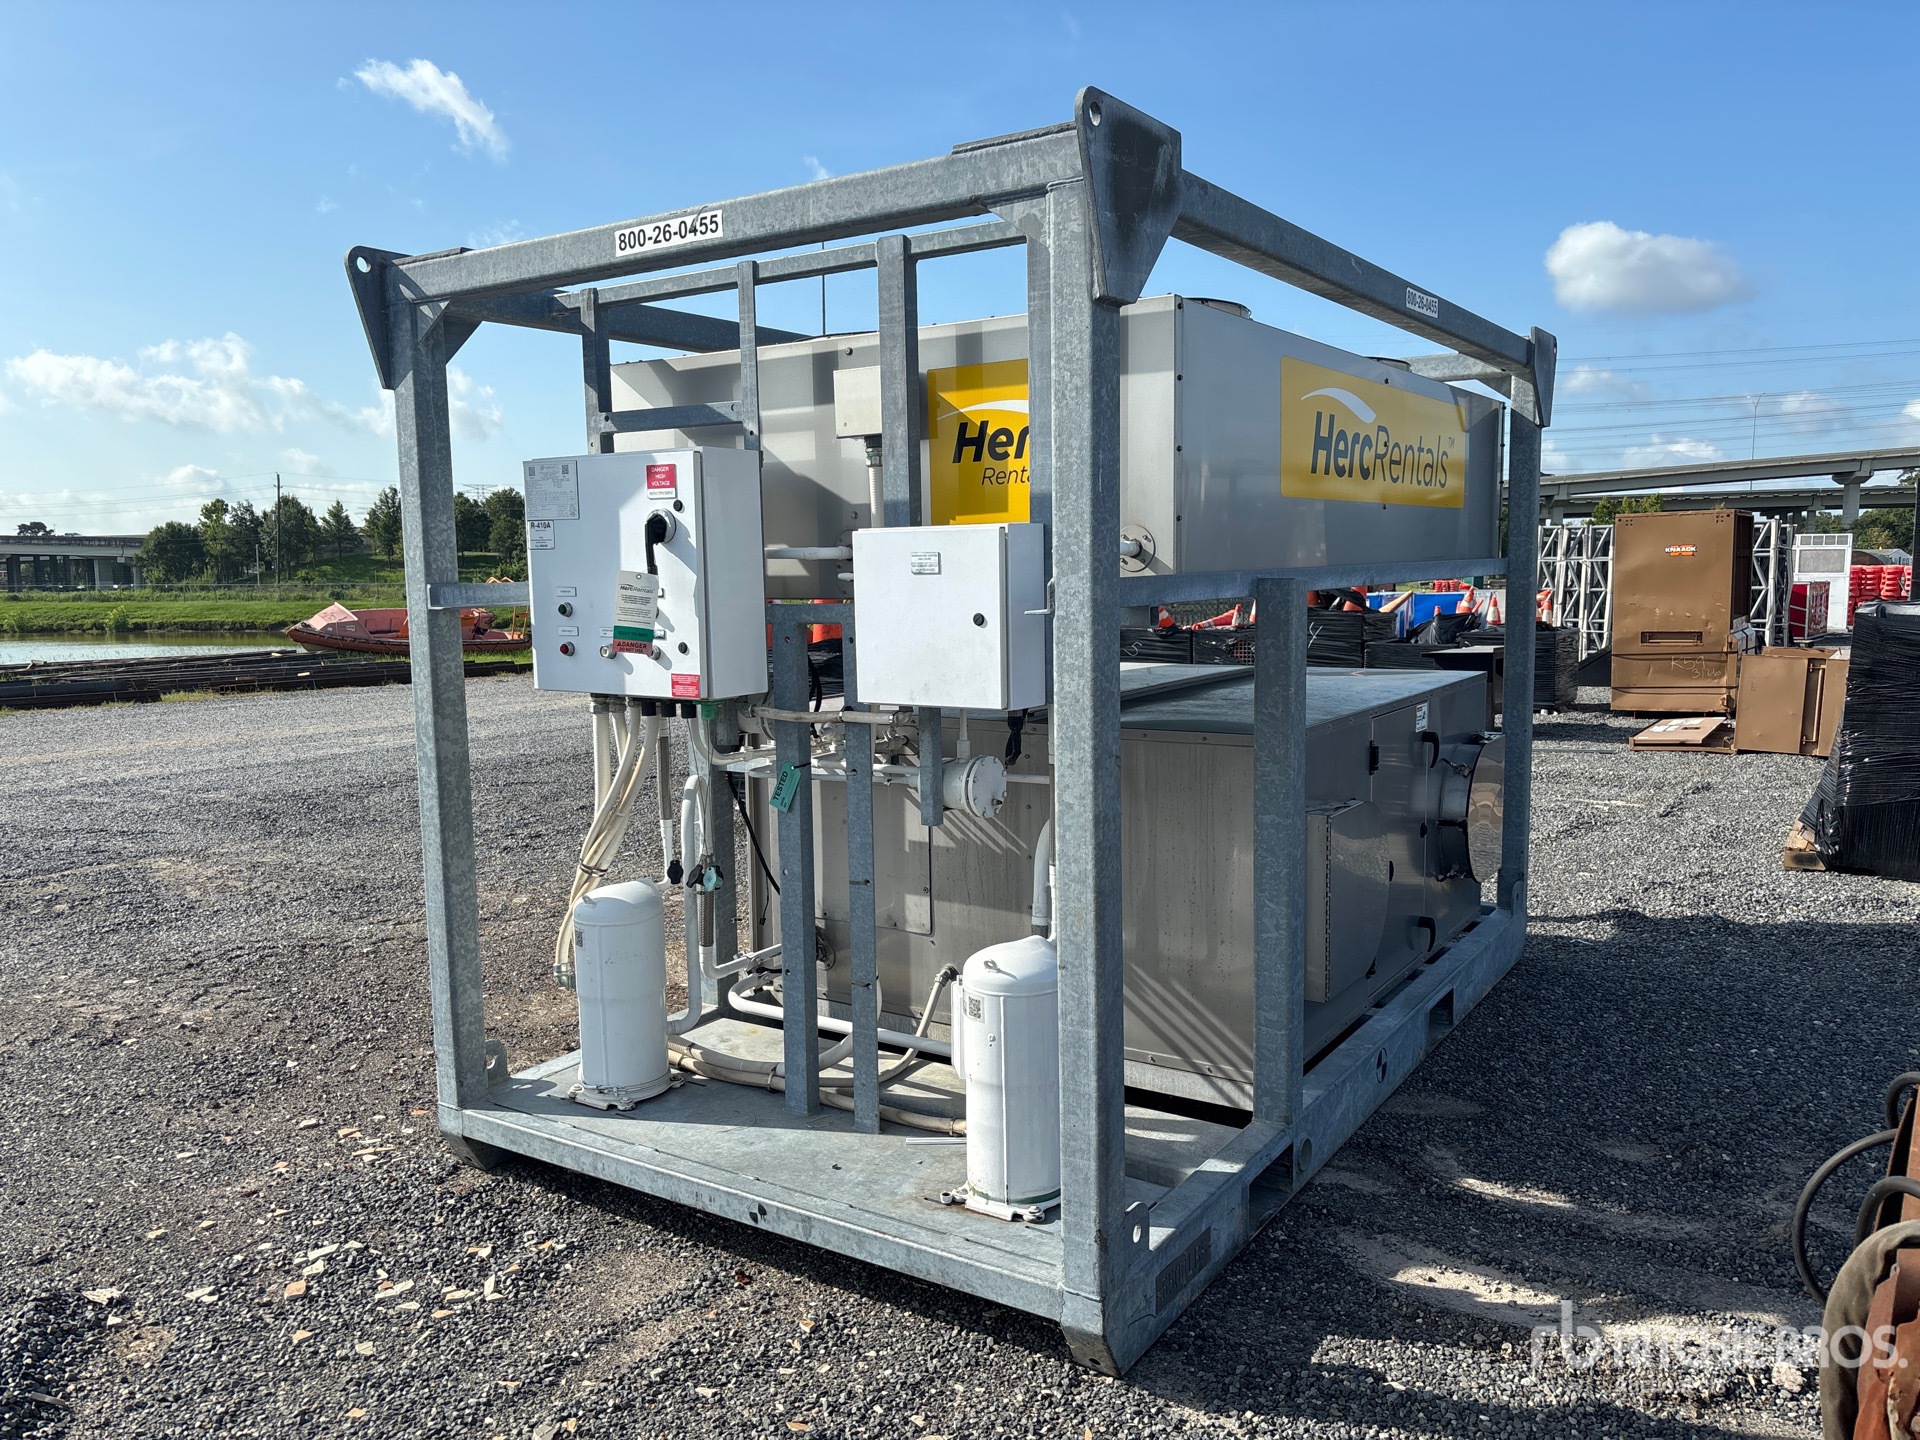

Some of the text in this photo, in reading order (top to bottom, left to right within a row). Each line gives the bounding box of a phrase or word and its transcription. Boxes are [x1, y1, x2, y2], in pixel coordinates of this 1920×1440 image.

[618, 214, 719, 251] 800-26-0455
[1407, 290, 1437, 314] 800-26-0455
[530, 521, 551, 529] R-410A
[622, 641, 648, 649] DANGER
[773, 771, 789, 801] TESTED
